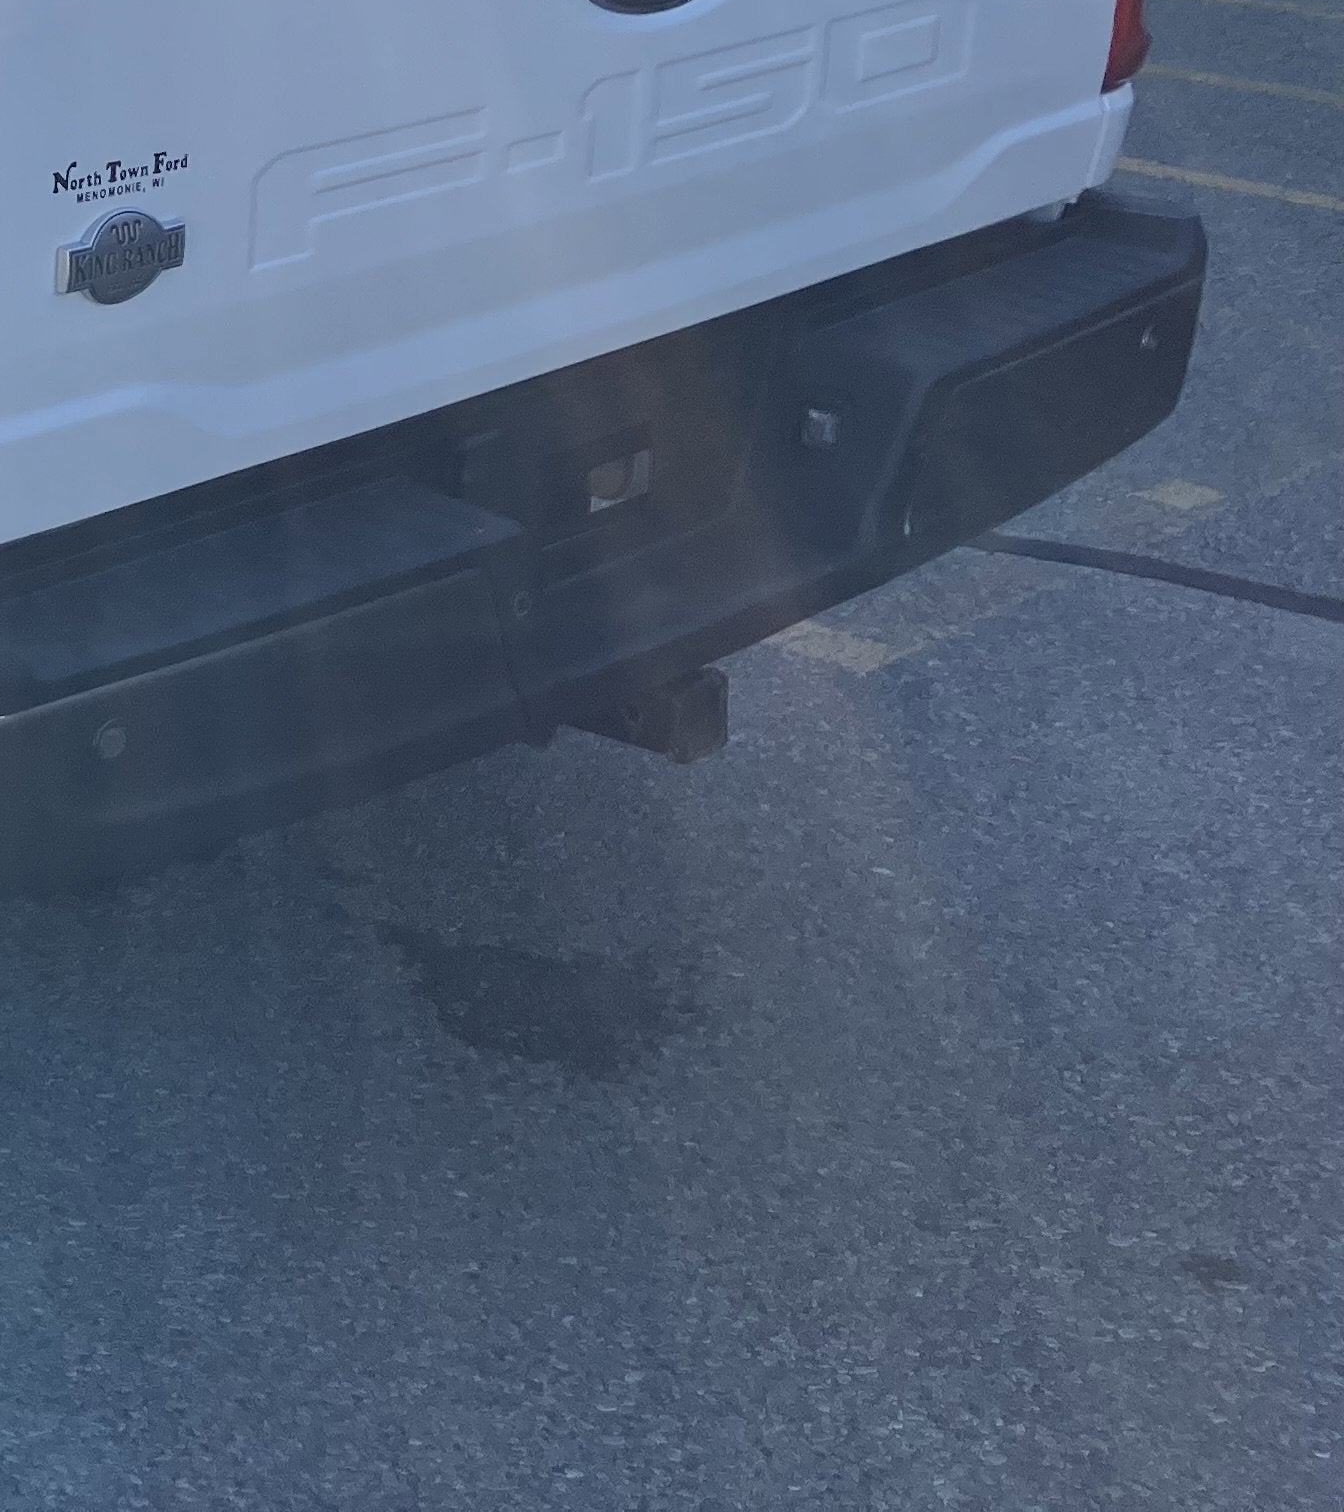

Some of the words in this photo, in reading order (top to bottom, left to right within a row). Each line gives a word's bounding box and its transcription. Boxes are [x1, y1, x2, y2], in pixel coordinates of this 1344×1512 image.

[52, 161, 102, 194] North
[106, 160, 149, 183] Town
[152, 151, 189, 175] Ford
[76, 181, 146, 203] MENOMONIE,
[152, 177, 165, 188] WI
[73, 251, 119, 284] KING
[123, 231, 181, 272] RANCH
